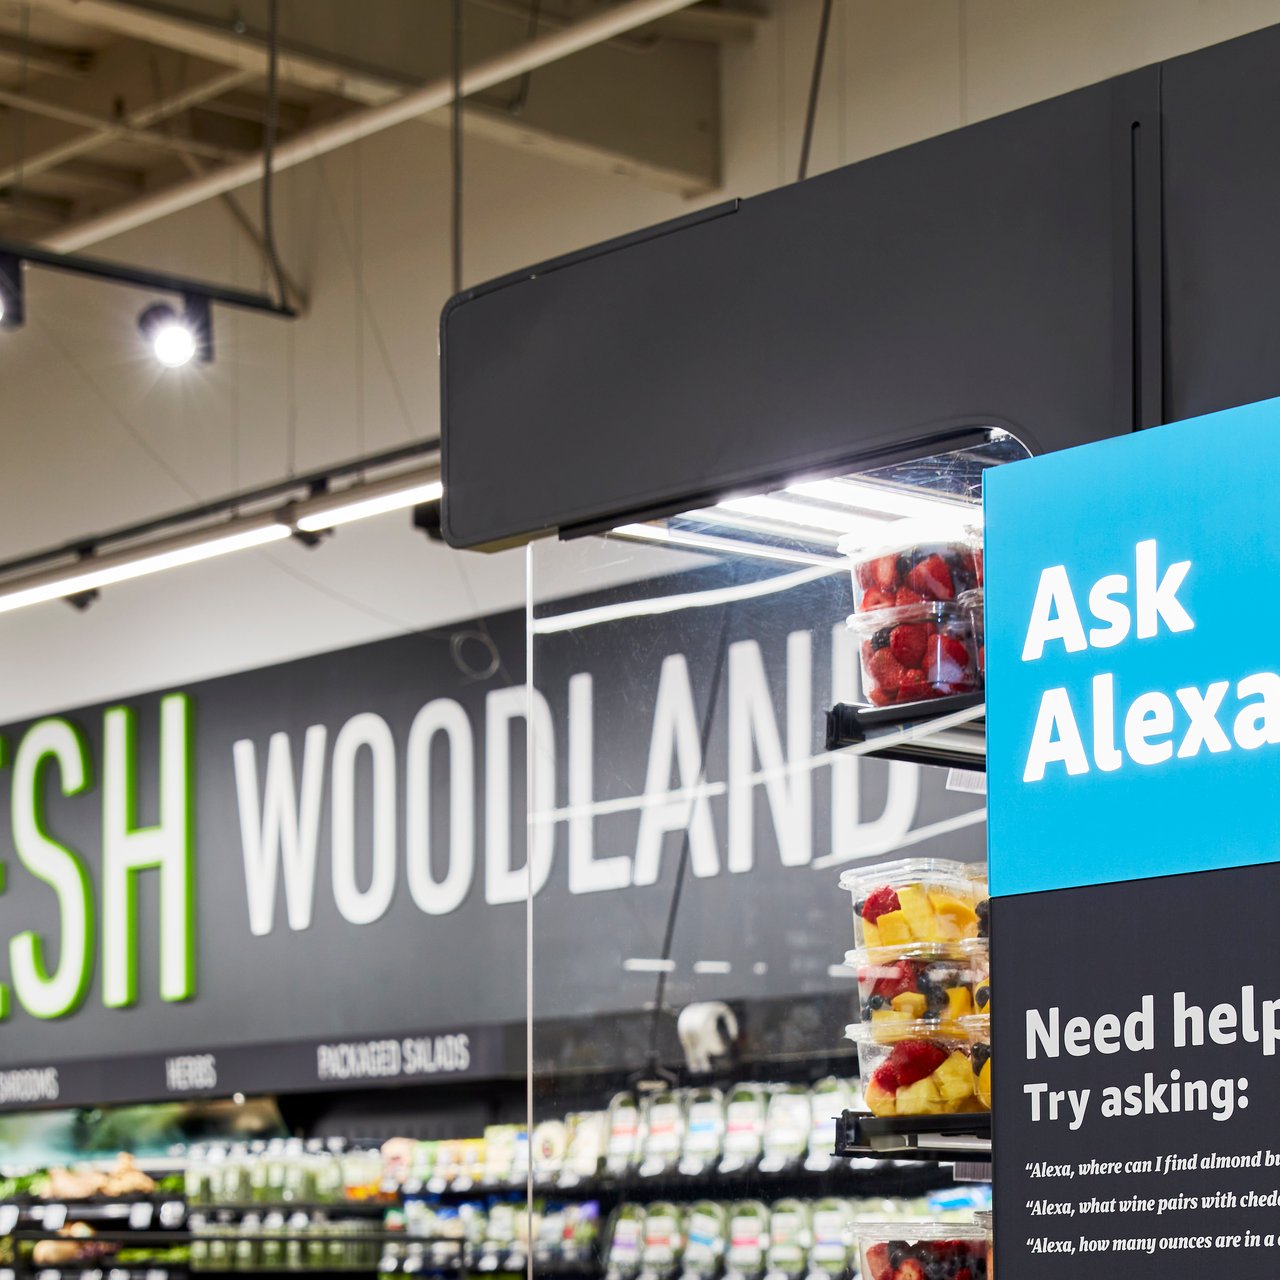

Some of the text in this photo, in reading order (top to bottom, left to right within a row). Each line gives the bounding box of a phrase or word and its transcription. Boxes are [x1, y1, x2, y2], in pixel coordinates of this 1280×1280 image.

[1021, 539, 1194, 661] Ask
[1026, 995, 1154, 1059] Need
[166, 1054, 217, 1090] HERBS
[317, 1034, 470, 1080] PACKAGED SALADS
[1023, 1069, 1249, 1130] Try asking:
[1078, 1159, 1122, 1176] where
[1124, 1160, 1152, 1173] can
[1155, 1156, 1162, 1172] I
[1162, 1154, 1198, 1175] find
[1201, 1151, 1262, 1169] almond
[1079, 1198, 1116, 1214] what
[1119, 1195, 1155, 1212] wine
[1157, 1193, 1198, 1215] pairs
[1201, 1191, 1236, 1208] with
[1079, 1236, 1110, 1252] how
[1112, 1238, 1156, 1254] many
[1159, 1237, 1212, 1249] ounces
[1215, 1233, 1241, 1248] are
[1244, 1230, 1260, 1247] in
[1264, 1234, 1274, 1247] a
